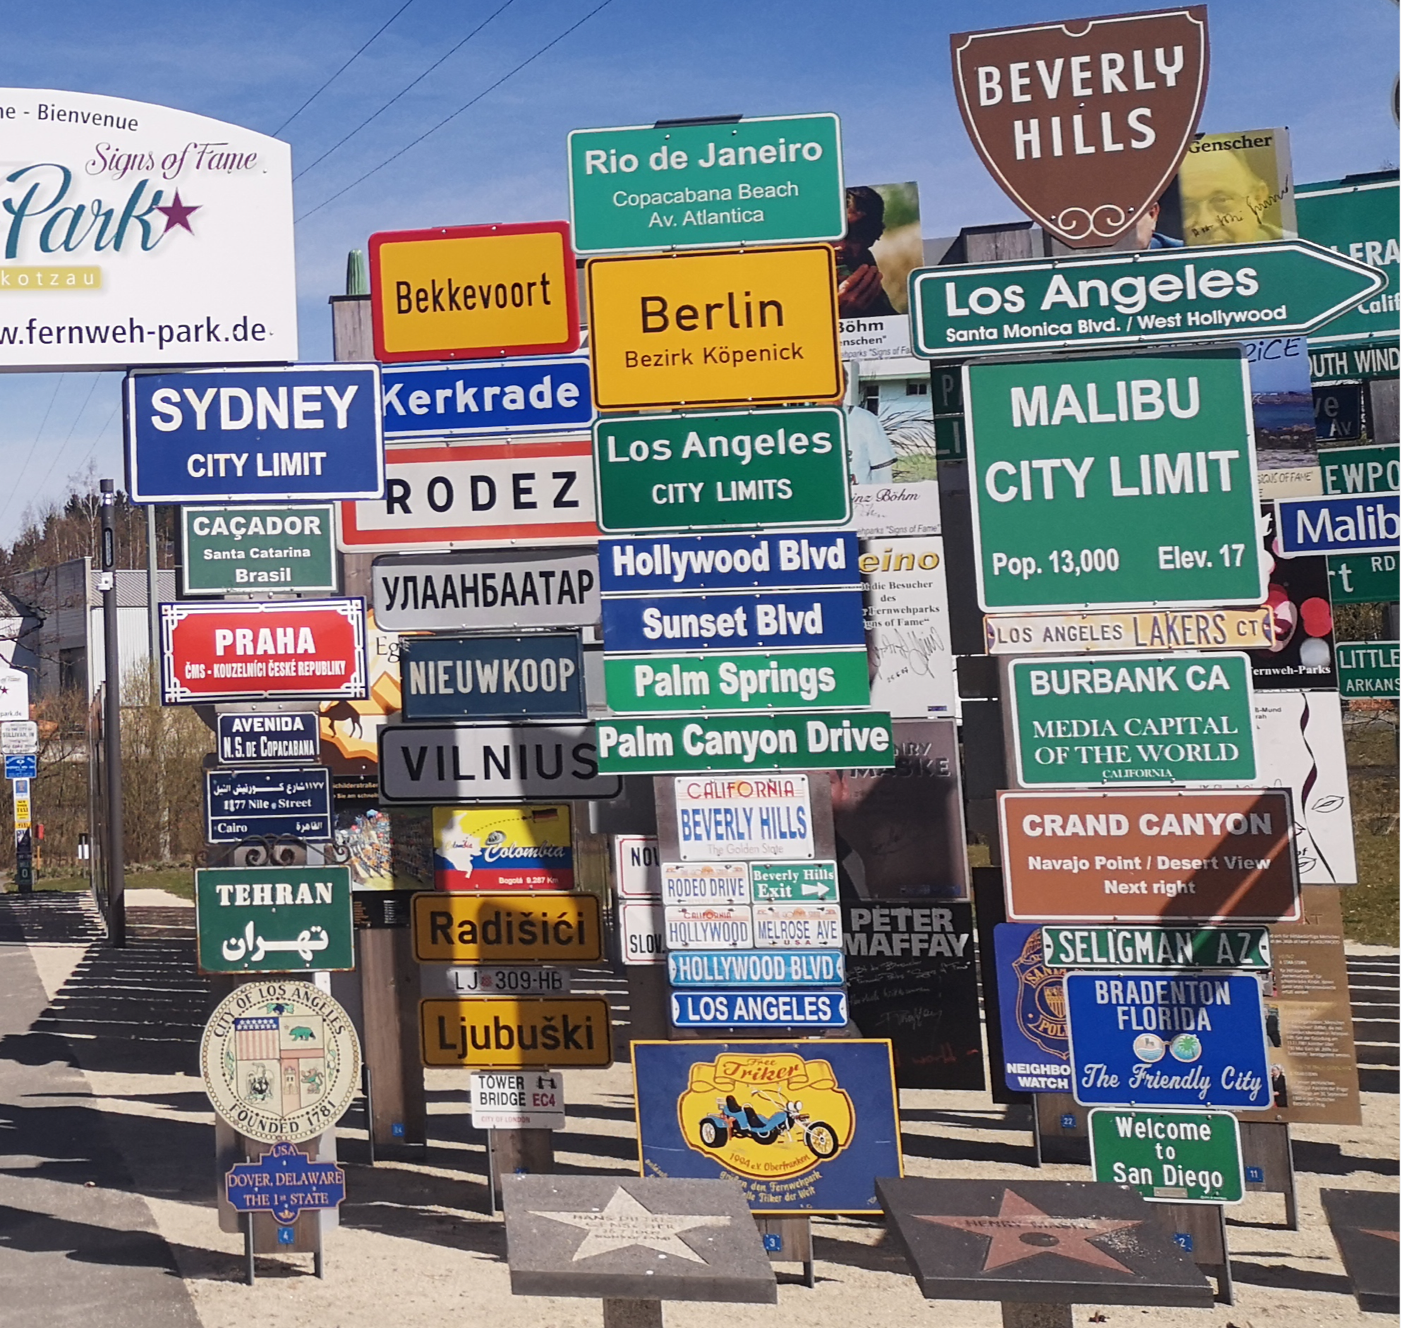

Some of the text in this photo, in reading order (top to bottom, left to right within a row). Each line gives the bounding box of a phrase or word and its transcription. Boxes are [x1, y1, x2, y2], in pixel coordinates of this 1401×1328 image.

[977, 45, 1185, 108] BEVERLY
[37, 104, 139, 132] Bienvenue
[1013, 107, 1158, 160] HILLS
[585, 138, 823, 175] Rio de Janeiro
[613, 180, 799, 208] Copacabana Beach
[396, 272, 551, 314] Bekkevoort
[946, 265, 1259, 317] Los Angeles
[641, 291, 784, 334] Berlin
[946, 305, 1287, 342] Santa Monica Blvd. West Hollywood
[625, 342, 804, 368] Bezirk Köpenick
[151, 386, 358, 431] SYDNEY
[383, 375, 579, 417] Kerkrade
[1010, 377, 1200, 427] MALIBU
[187, 452, 326, 478] CITY LIMIT
[386, 471, 579, 515] RODEZ
[193, 516, 321, 540] CAÇADOR
[203, 547, 311, 560] Santa Catarina
[613, 538, 846, 582] Hollywood Blvd
[235, 568, 291, 582] Brasil
[382, 569, 594, 611] УЛААНБААТАР
[215, 627, 316, 655] PRAHA
[185, 659, 346, 679] ČMS KOUZELNÍCI ČESKÉ REPUBLIKY
[410, 658, 575, 695] NIEUWKOOP
[232, 717, 304, 732] AVENIDA
[599, 720, 889, 763] Palm Canyon Drive
[1103, 769, 1173, 778] CALIFORNIA
[248, 799, 312, 809] Nile Street
[218, 823, 248, 833] Cairo
[1139, 813, 1272, 836] CANYON
[668, 878, 744, 897] RODEO DRIVE
[754, 869, 834, 882] Beverly Hills
[216, 883, 332, 906] TEHRAN
[758, 884, 792, 898] Exit
[430, 911, 585, 946] Radišići
[758, 921, 837, 939] MELROSE AVE
[850, 908, 954, 932] PETER
[222, 921, 329, 961] تهران
[1059, 932, 1253, 964] SELIGMAN AZ
[1095, 980, 1231, 1005] BRADENTON
[688, 997, 832, 1021] LOS ANGELES
[1117, 1006, 1211, 1031] FLORIDA
[438, 1015, 594, 1059] Ljubuški
[479, 1076, 525, 1090] TOWER
[1082, 1064, 1262, 1101] The Friendly City
[480, 1092, 555, 1107] BRIDGE EC4
[228, 1102, 336, 1134] FOUNDED 1781
[1115, 1117, 1211, 1141] Welcome
[1155, 1143, 1175, 1159] to
[229, 1172, 342, 1187] DOVER, DELAWARE
[1113, 1162, 1223, 1194] San Diego
